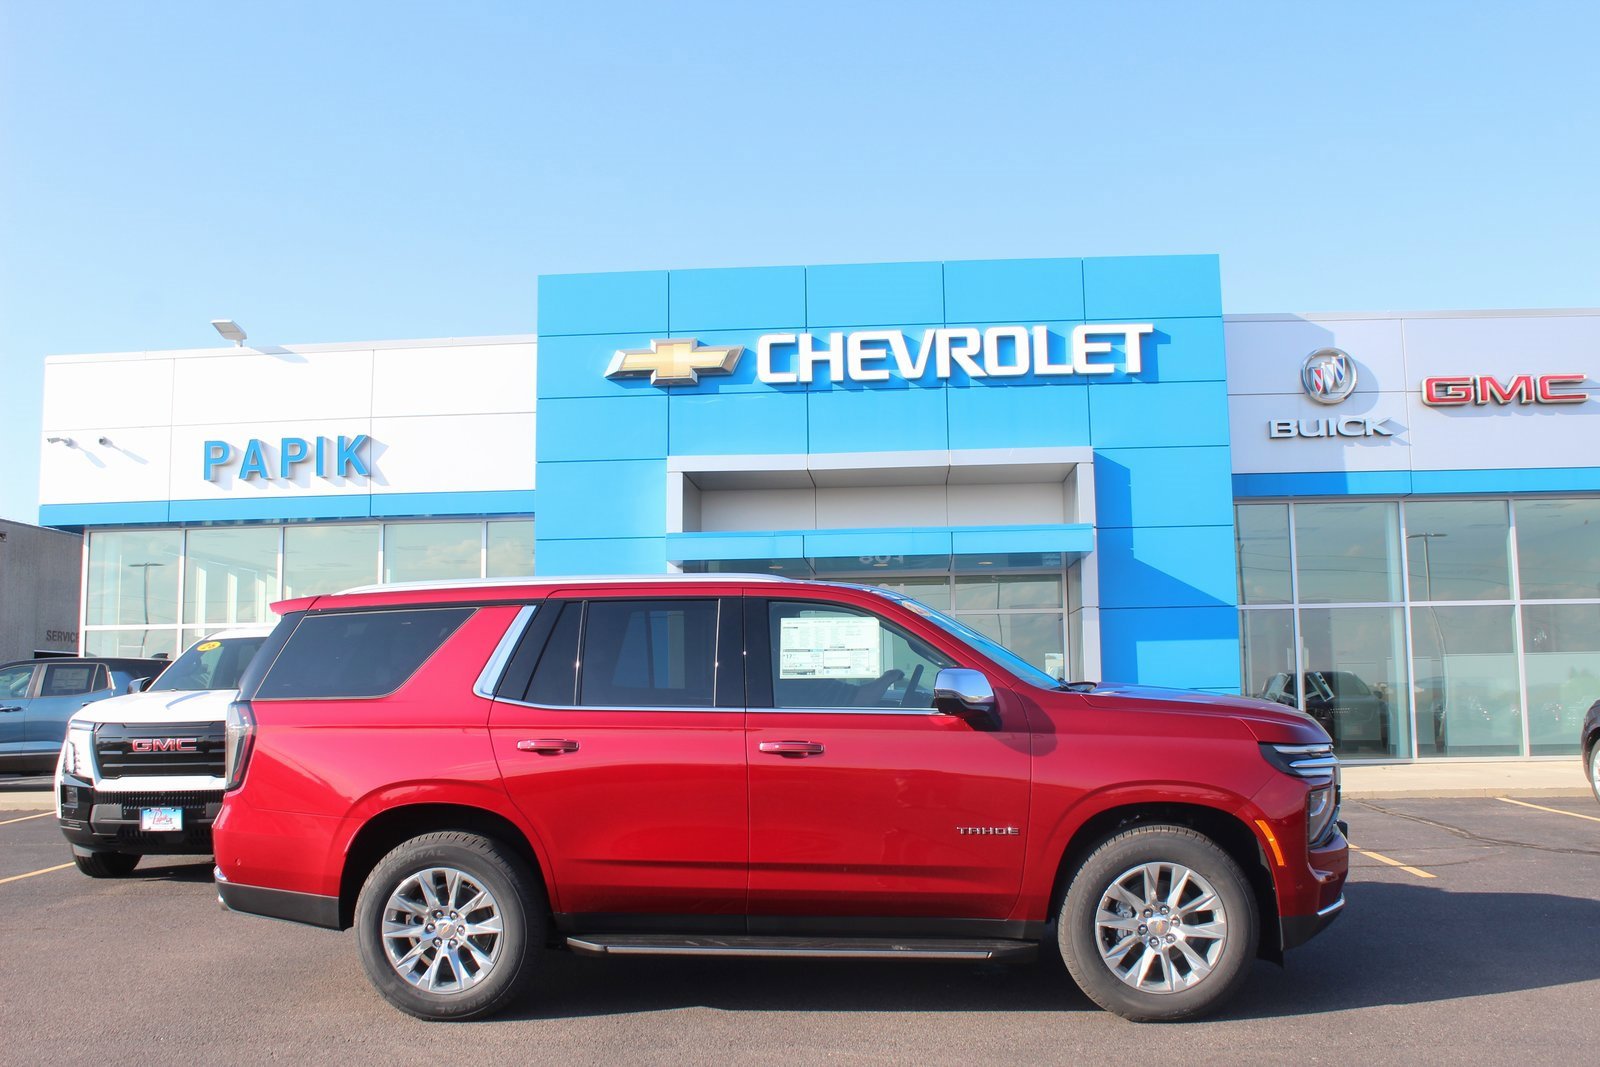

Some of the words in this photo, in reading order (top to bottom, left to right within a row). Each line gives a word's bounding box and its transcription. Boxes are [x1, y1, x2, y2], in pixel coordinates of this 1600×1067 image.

[756, 323, 1154, 384] CHEVROLET
[1421, 374, 1589, 406] GMC
[1268, 417, 1394, 439] BUICK
[203, 433, 371, 482] PAPIK
[132, 738, 198, 752] GMC
[956, 826, 1019, 835] TAHOE
